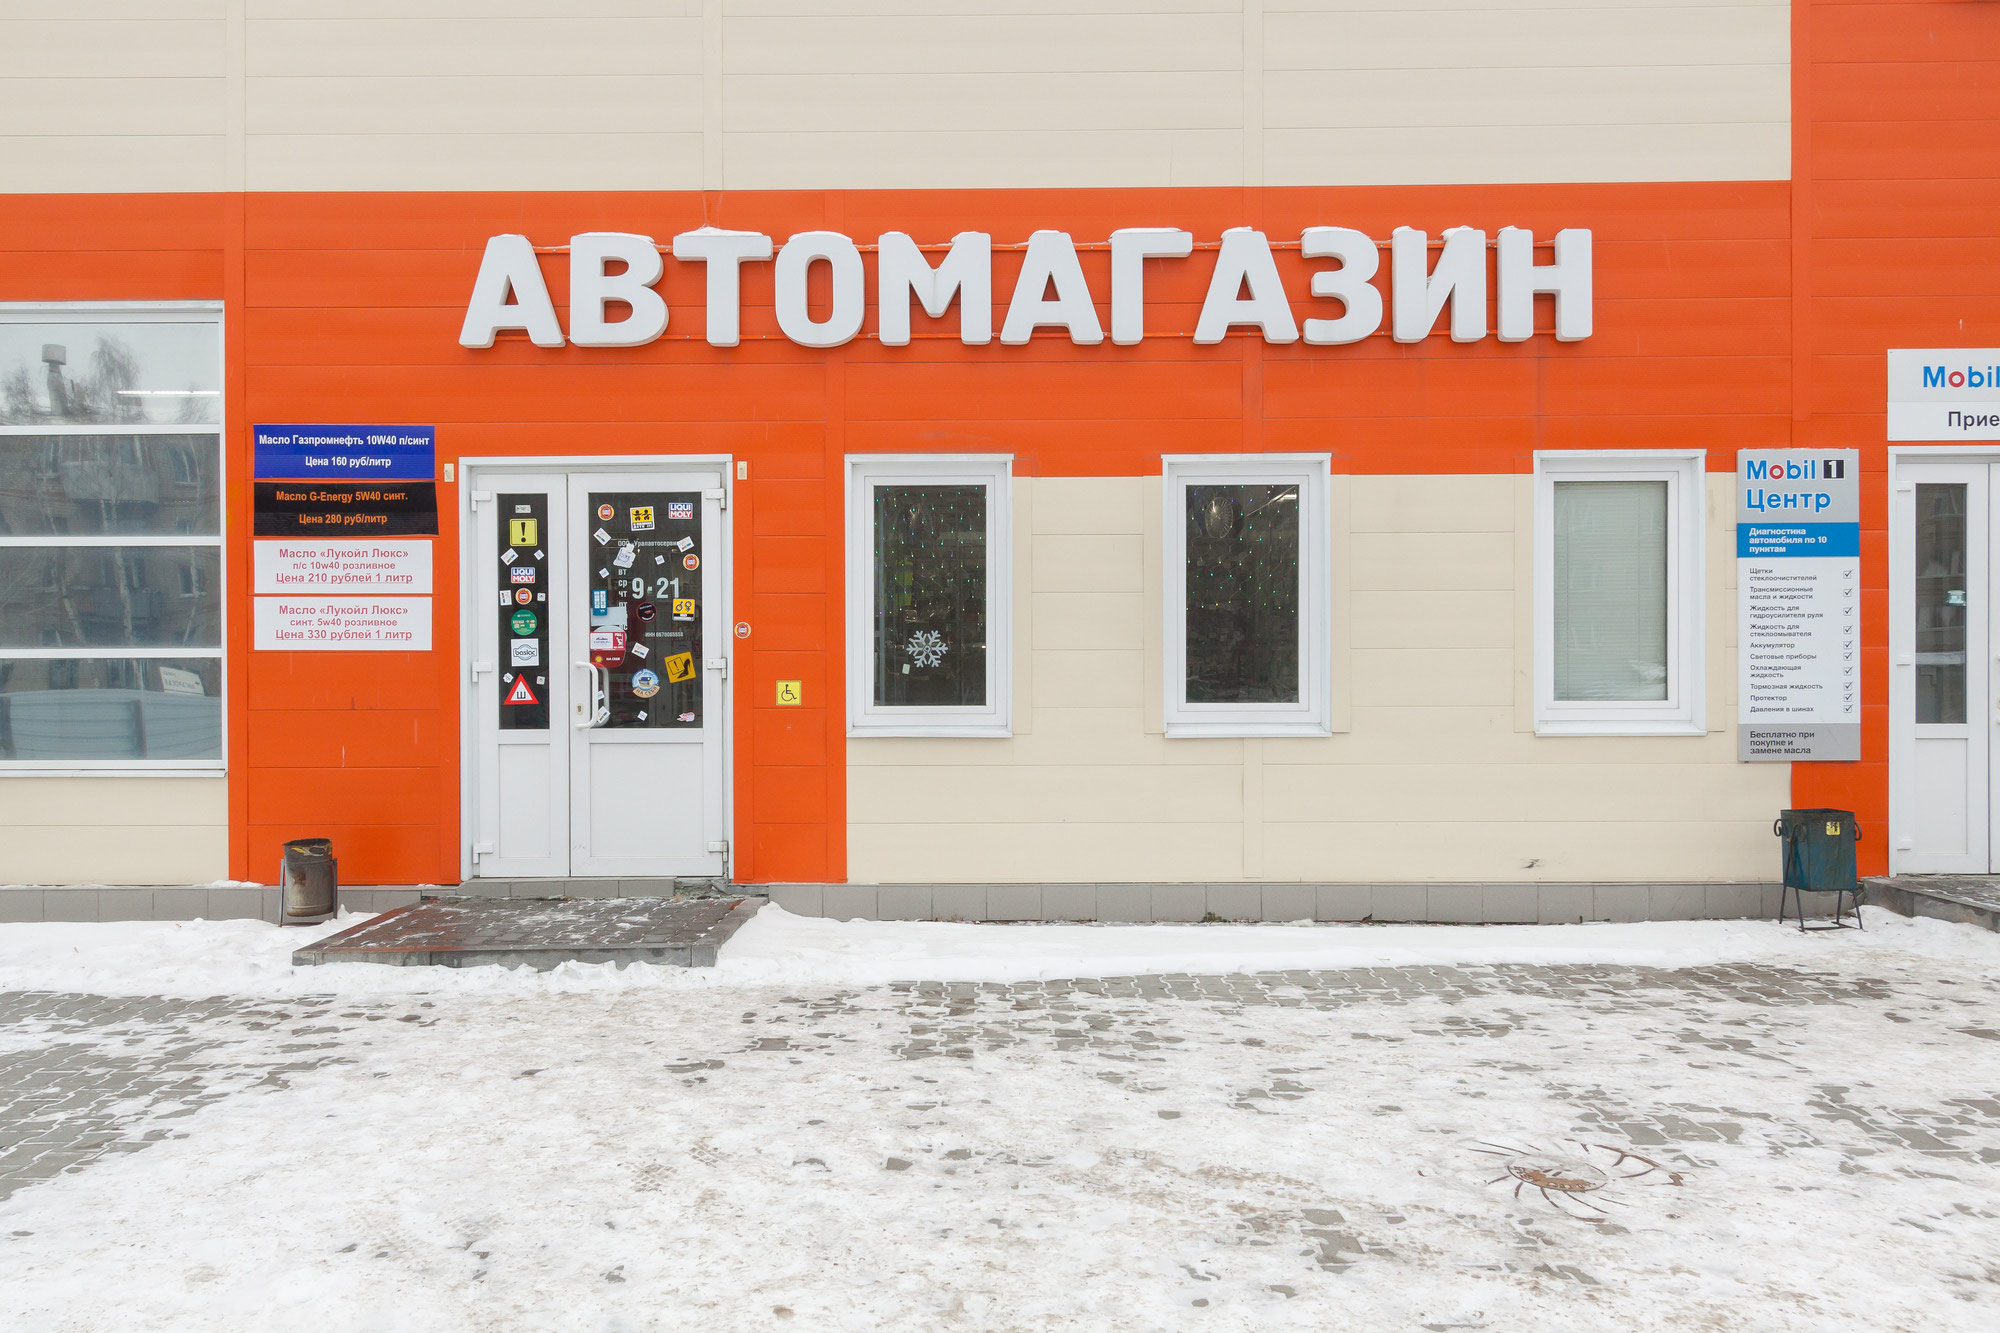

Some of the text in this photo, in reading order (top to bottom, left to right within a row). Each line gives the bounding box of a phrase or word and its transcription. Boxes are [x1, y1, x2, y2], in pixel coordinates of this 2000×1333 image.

[459, 228, 1595, 349] АВТОМАГАЗИН
[1923, 366, 2000, 388] Mobil
[259, 434, 430, 446] Масло Газпромнефть 10W40 п/синт
[306, 456, 391, 468] Цена 160 руб/литр
[1746, 460, 1839, 480] Mobil 1
[276, 491, 408, 503] Масло G-Energy 5W40 синт.
[1746, 489, 1831, 513] Центр
[299, 514, 387, 525] Цена 280 руб/литр
[1749, 528, 1806, 536] Диагностика
[279, 548, 409, 560] Масло «Лукойл Люкс»
[293, 561, 396, 571] п/с 10w40 розливное
[276, 572, 413, 584] Цена 210 рублей 1 литр
[279, 605, 408, 616] Масло «Лукойл Люкс»
[317, 618, 342, 626] 5w40
[344, 619, 398, 628] розливное
[276, 629, 412, 641] Цена 330 рублей 1 литр
